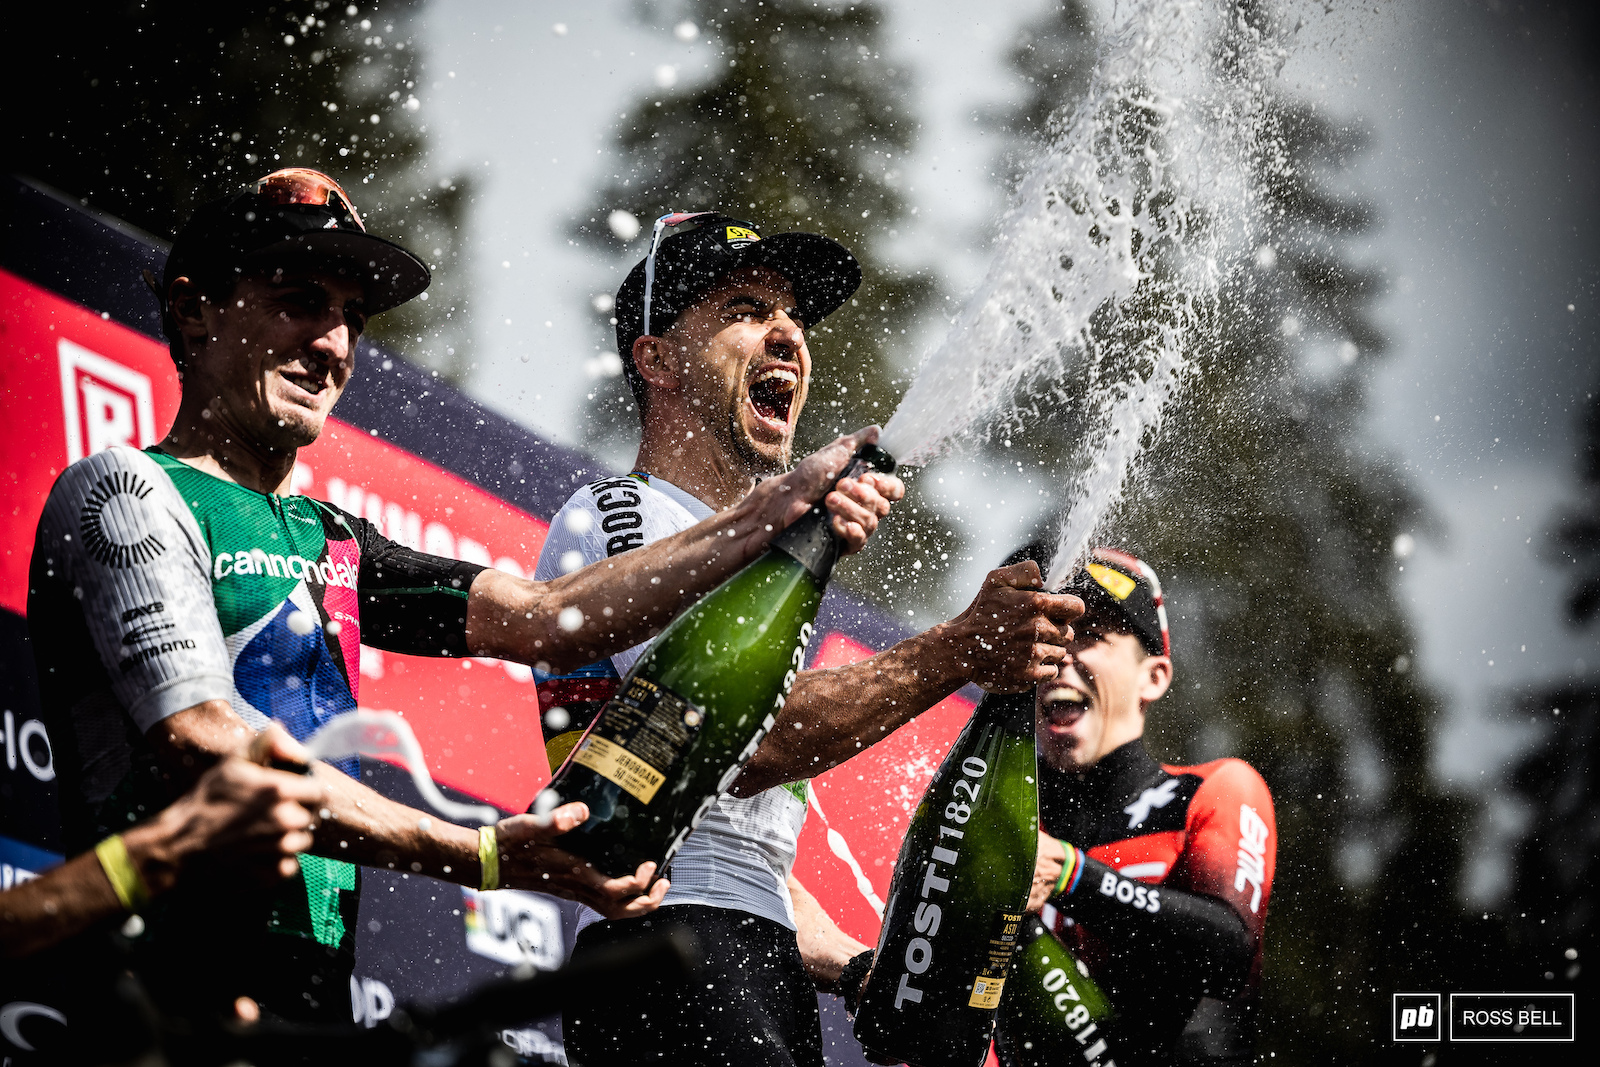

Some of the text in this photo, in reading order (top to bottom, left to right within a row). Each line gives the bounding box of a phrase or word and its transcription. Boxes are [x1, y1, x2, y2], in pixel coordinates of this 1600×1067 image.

[213, 550, 359, 592] cannondale
[614, 753, 660, 787] JEROBOAM
[1100, 871, 1161, 914] BOSS
[1003, 914, 1022, 922] TOSTI
